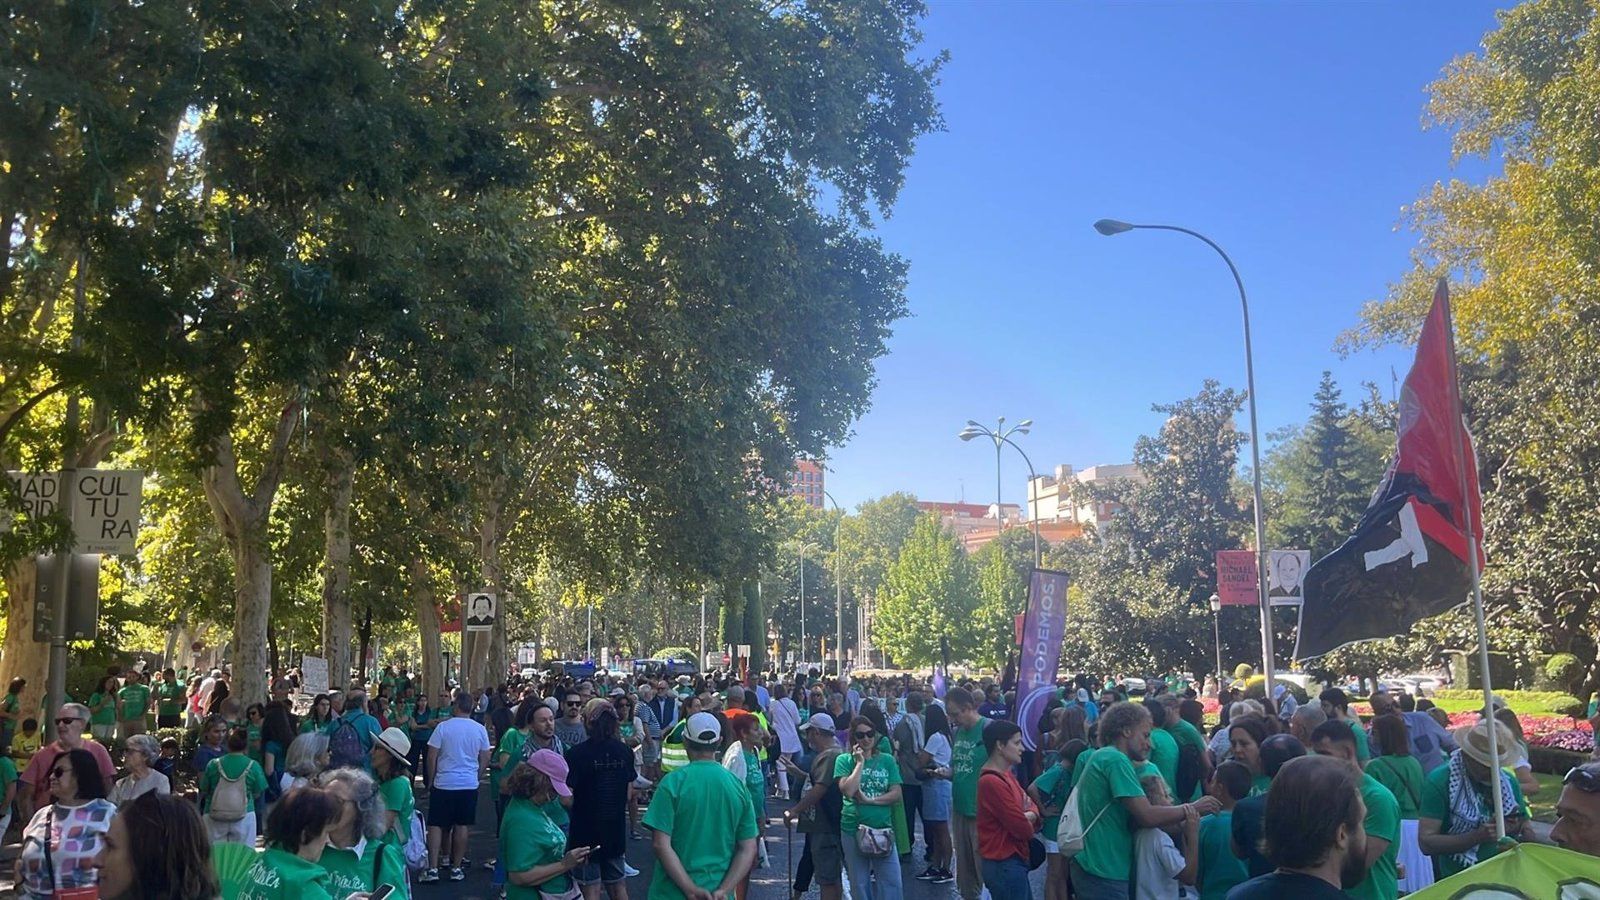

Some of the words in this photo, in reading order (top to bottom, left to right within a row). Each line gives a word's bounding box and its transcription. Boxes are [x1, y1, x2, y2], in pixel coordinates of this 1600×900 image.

[79, 476, 129, 496] CUL
[21, 499, 54, 519] RID
[86, 498, 119, 518] TU
[101, 519, 134, 539] RA
